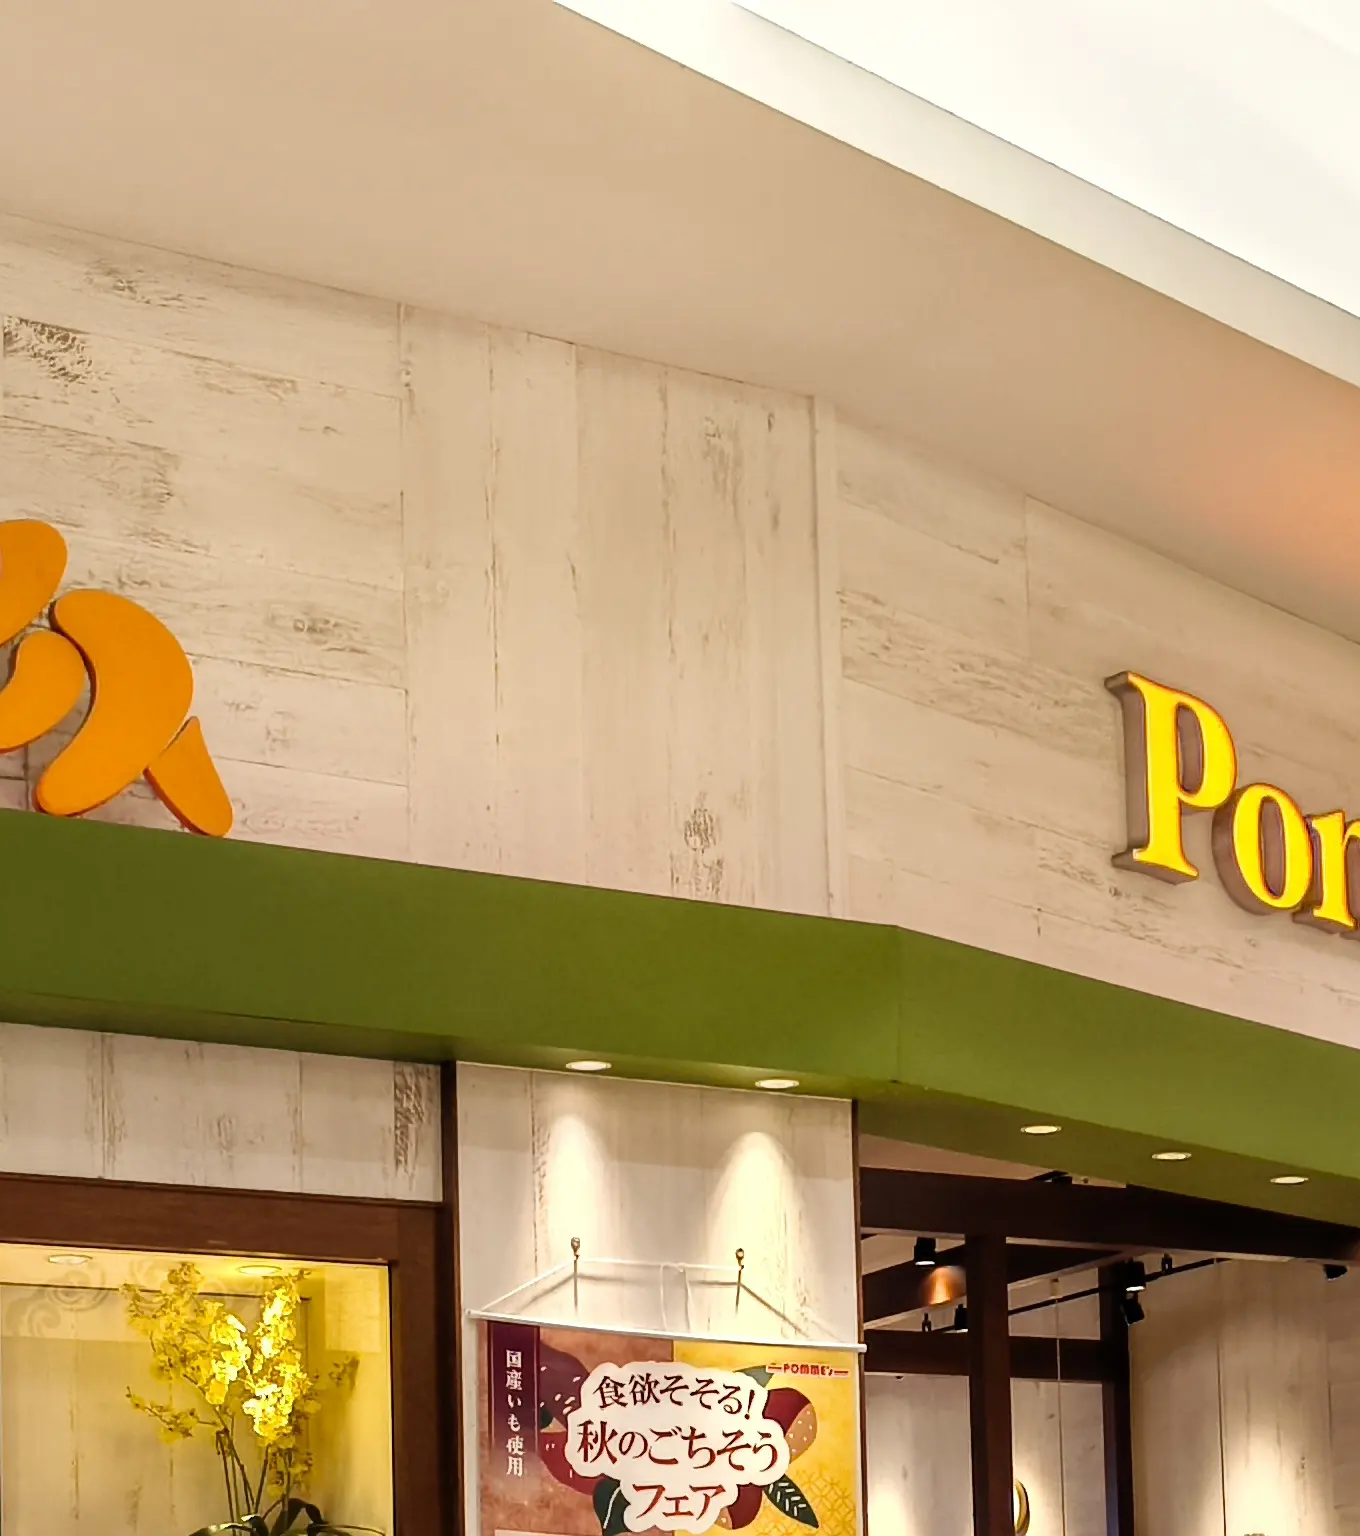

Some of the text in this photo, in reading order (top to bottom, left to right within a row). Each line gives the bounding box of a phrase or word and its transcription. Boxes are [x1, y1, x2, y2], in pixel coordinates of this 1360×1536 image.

[504, 1349, 525, 1477] 国産いも使用
[592, 1374, 757, 1421] 食欲そそる!
[576, 1417, 779, 1473] 秋のごちそう
[631, 1482, 727, 1522] フェア
